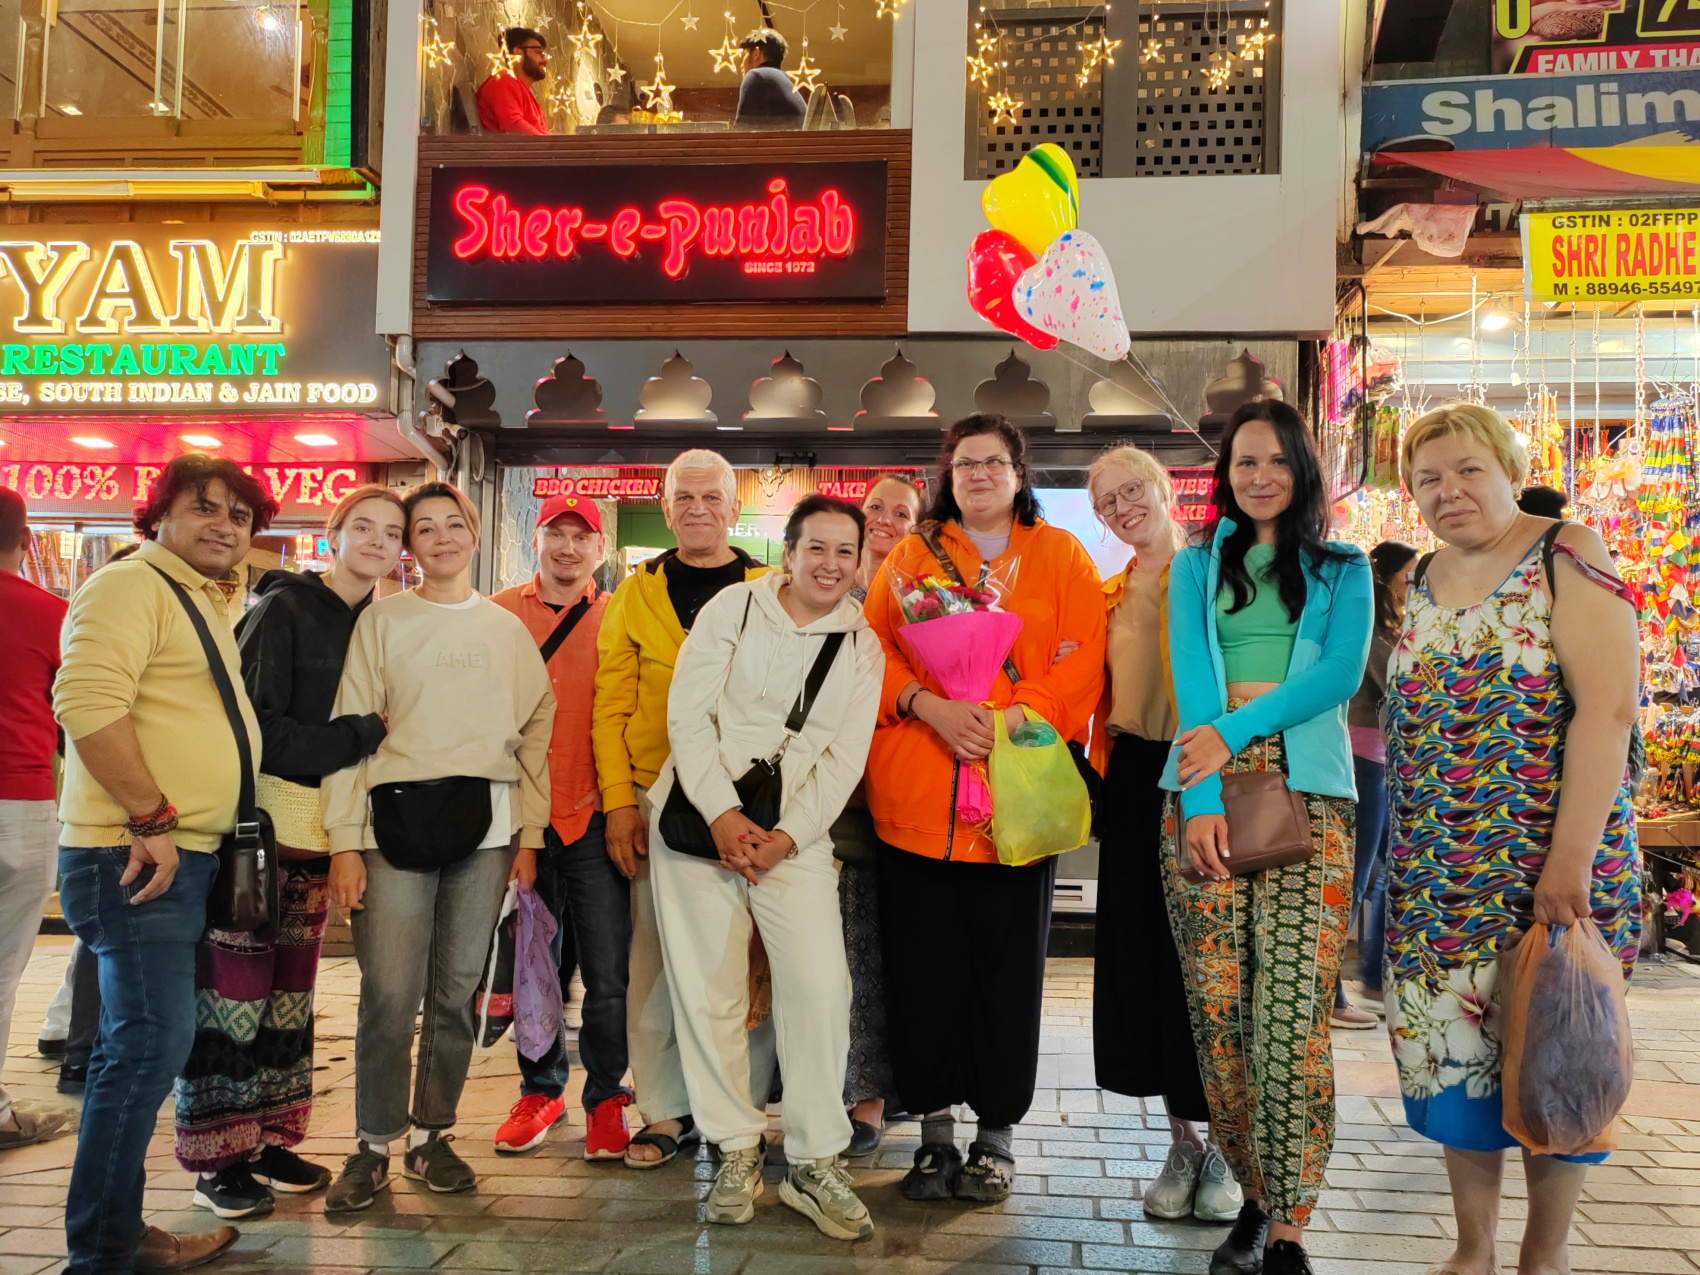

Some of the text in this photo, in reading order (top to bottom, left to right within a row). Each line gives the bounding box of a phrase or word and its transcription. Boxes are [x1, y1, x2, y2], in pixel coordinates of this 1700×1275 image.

[1538, 50, 1640, 72] FAMILY
[1421, 82, 1700, 136] Shalim
[1552, 215, 1611, 229] GSTIN
[1629, 212, 1698, 227] 02FFPP
[250, 231, 282, 243] GSTIN
[1552, 232, 1696, 278] SHRI RADHE
[744, 261, 815, 273] SINCE 1972
[0, 241, 284, 334] YAM
[1554, 283, 1568, 295] M
[1, 343, 285, 375] RESTAURANT
[39, 383, 122, 402] SOUTH
[128, 383, 213, 402] INDIAN
[218, 383, 239, 402] &
[243, 383, 301, 402] JAIN
[307, 383, 377, 402] FOOD
[2, 464, 119, 499] 100%
[264, 467, 357, 505] VEG
[575, 479, 659, 495] CHICKEN
[818, 482, 867, 498] TAKE
